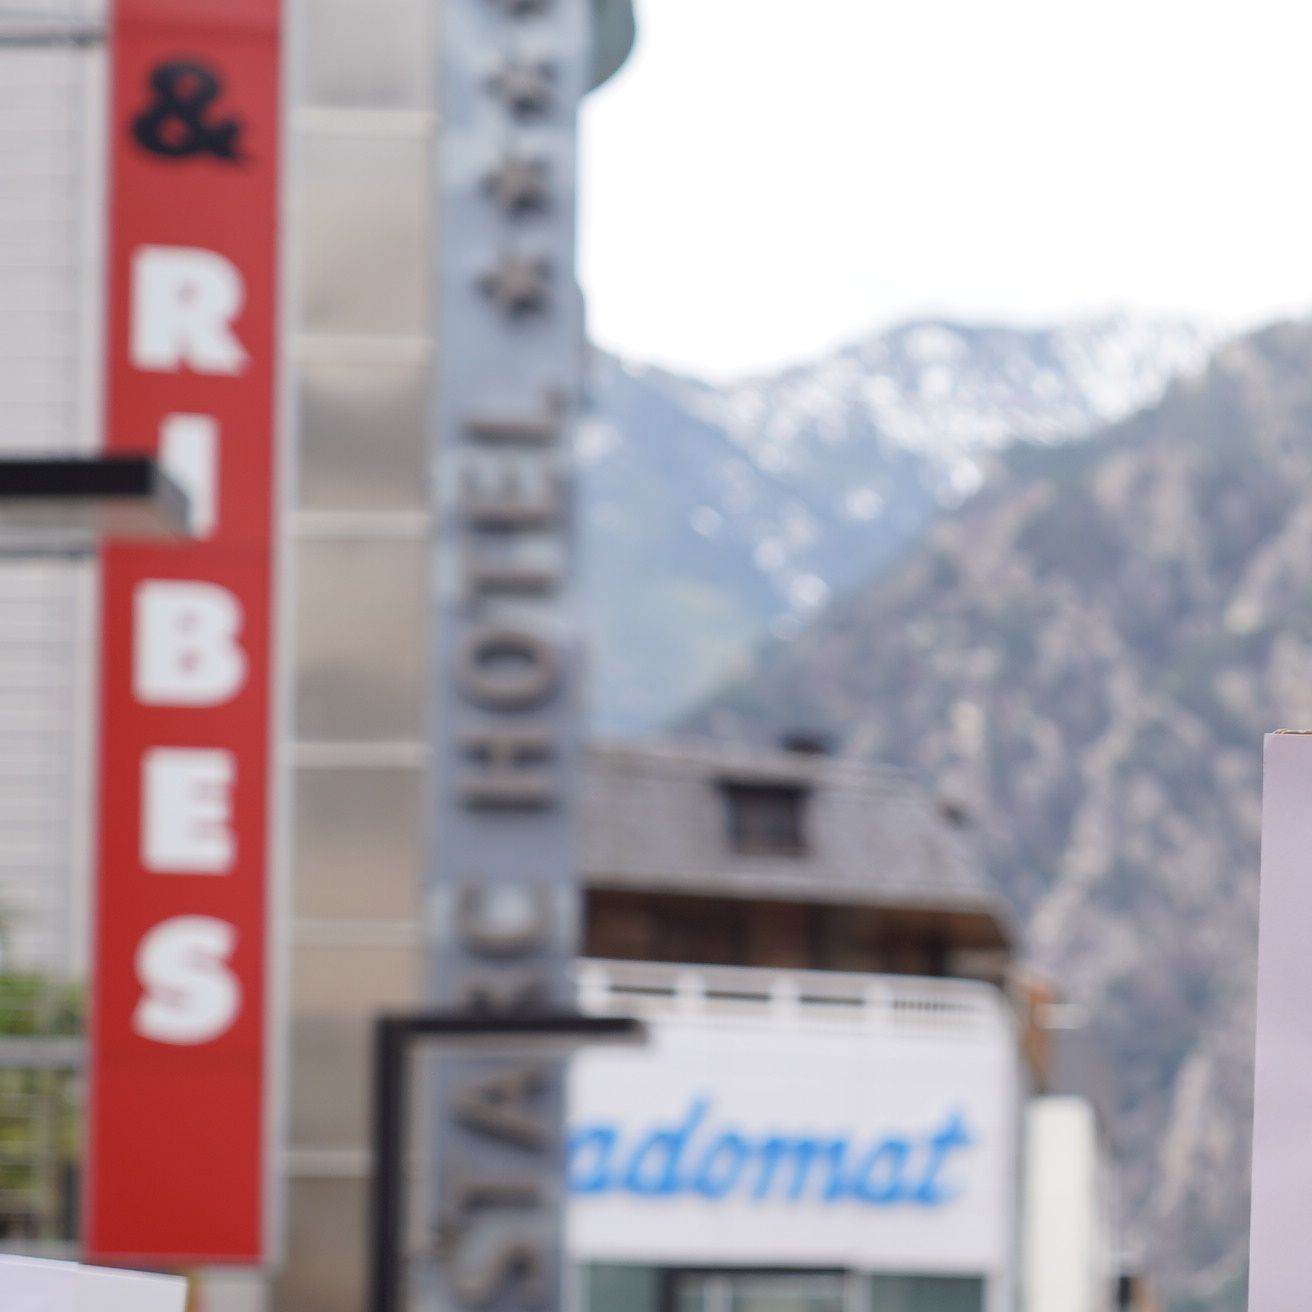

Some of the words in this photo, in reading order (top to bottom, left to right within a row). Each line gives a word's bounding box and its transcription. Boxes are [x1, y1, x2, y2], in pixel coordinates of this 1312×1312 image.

[130, 52, 252, 172] &
[130, 243, 252, 1047] RIBES
[455, 386, 565, 812] HOTEL
